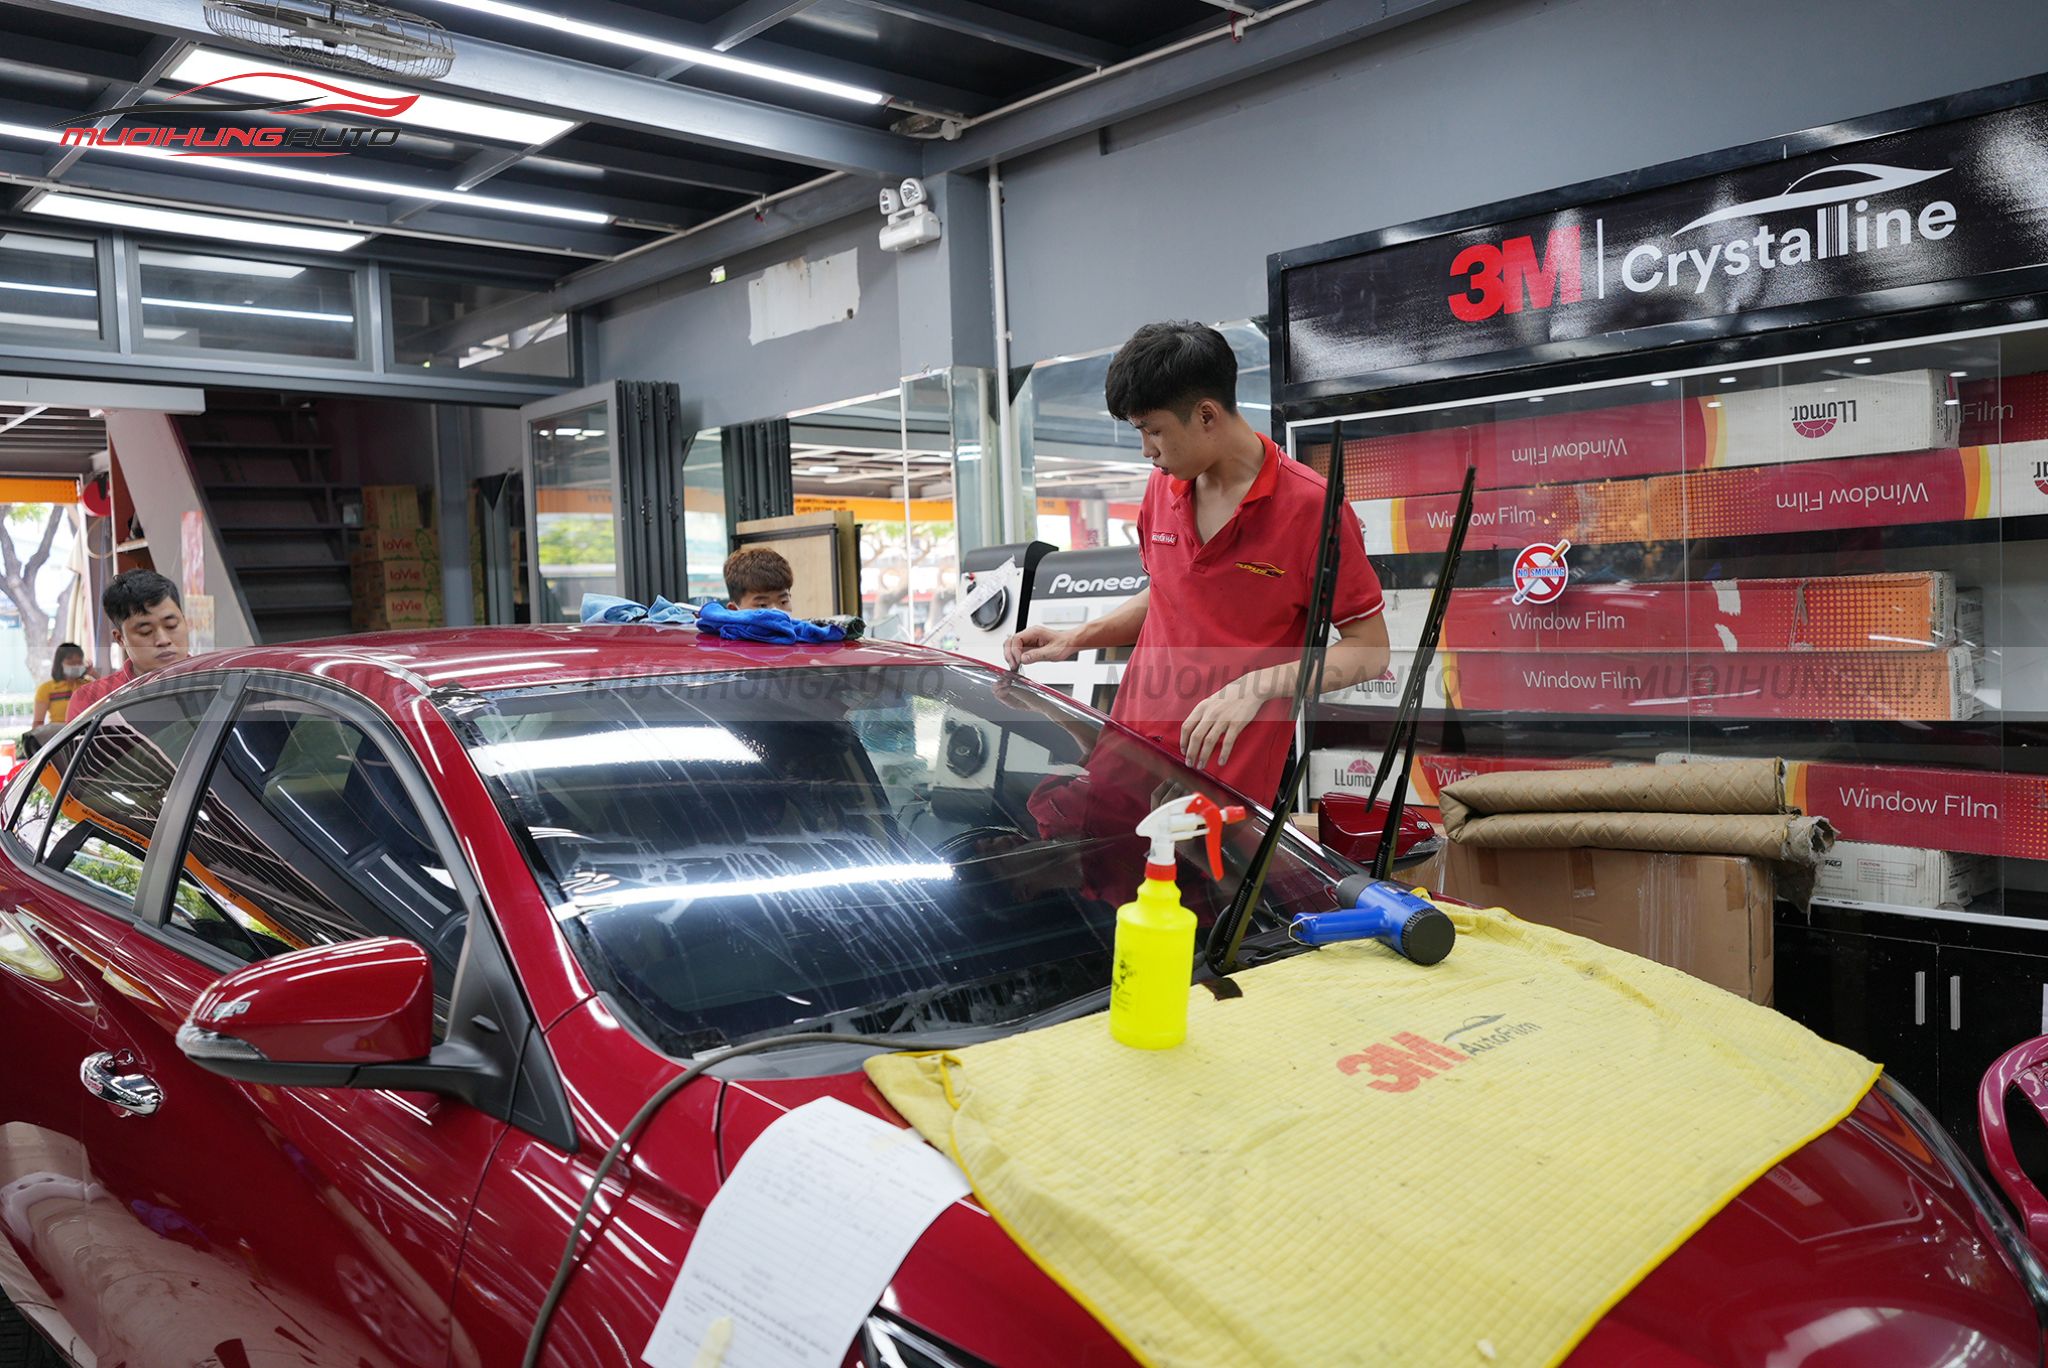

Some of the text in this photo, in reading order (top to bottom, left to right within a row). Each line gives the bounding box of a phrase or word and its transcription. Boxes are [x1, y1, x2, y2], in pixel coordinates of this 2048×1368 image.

[1448, 199, 1958, 322] 3M Crystalline
[1791, 399, 1857, 423] LLumar
[1962, 400, 2014, 424] Film
[1511, 438, 1628, 466] Window Film
[1776, 482, 1929, 513] Window Film
[1426, 505, 1536, 529] Winow Film
[1048, 573, 1149, 595] Pioneer
[1518, 567, 1565, 577] NO SMOKING
[1508, 611, 1625, 631] Window Film
[1522, 671, 1642, 690] Window Film
[1334, 768, 1377, 788] LLuma
[1838, 786, 1998, 819] Window Film
[1336, 1031, 1471, 1093] 3M
